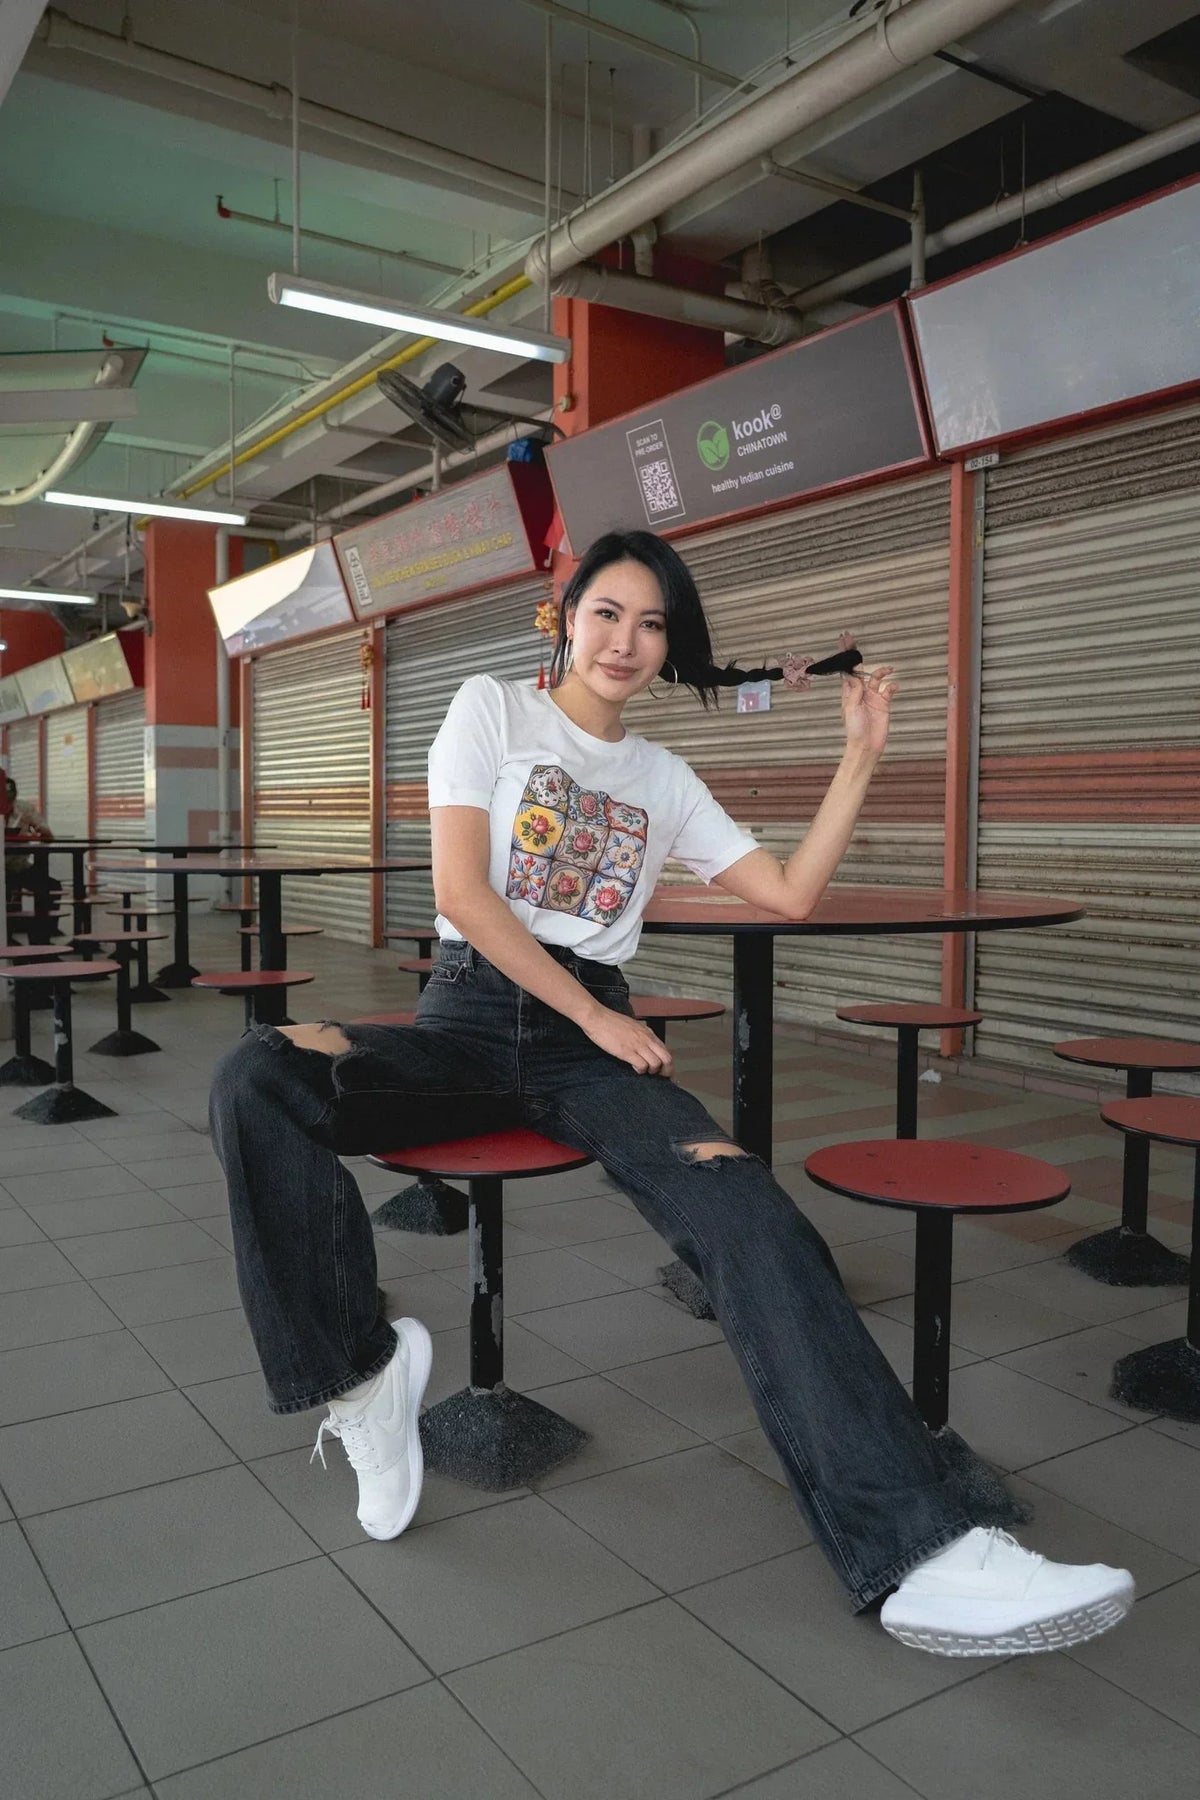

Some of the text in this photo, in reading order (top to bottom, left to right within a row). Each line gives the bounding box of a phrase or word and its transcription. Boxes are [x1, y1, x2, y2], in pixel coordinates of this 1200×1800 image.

[732, 404, 782, 440] kook@
[635, 441, 664, 456] PRE-ORDER
[636, 433, 658, 447] SCAN TO
[737, 431, 788, 457] CHINATOWN
[711, 461, 794, 494] healthy Indian cuisine
